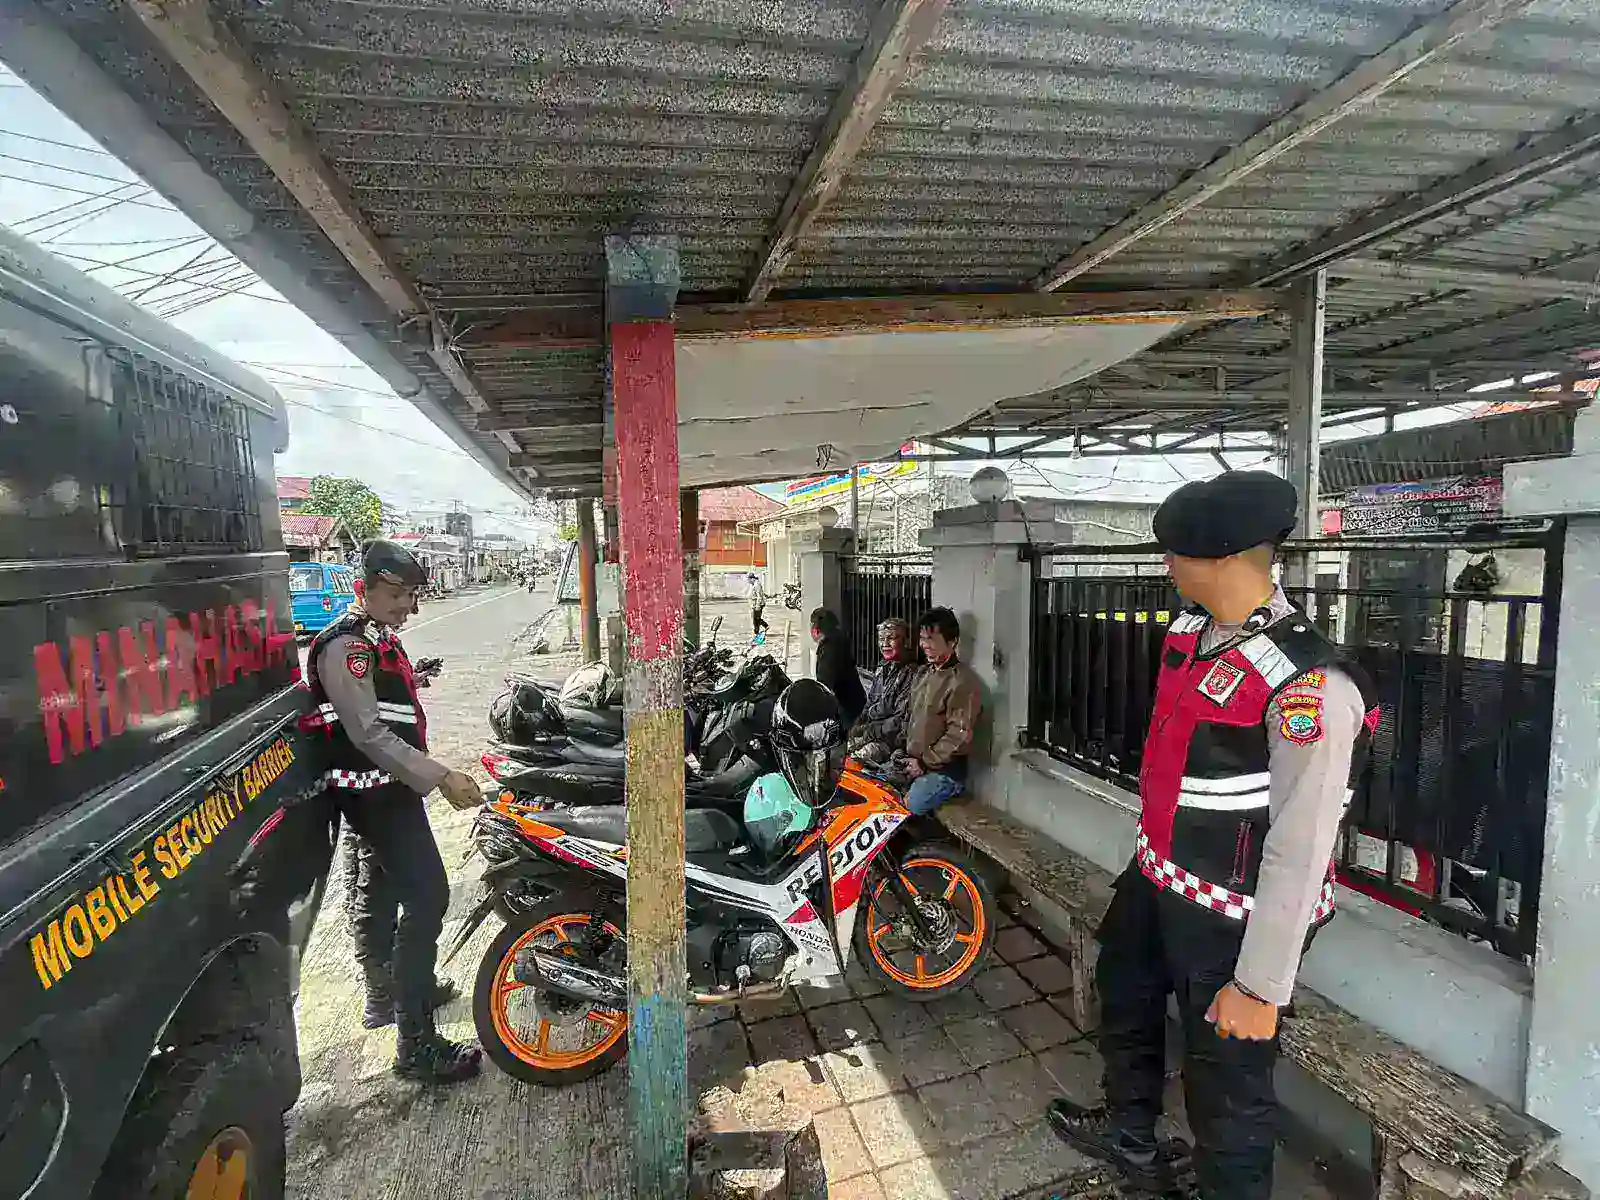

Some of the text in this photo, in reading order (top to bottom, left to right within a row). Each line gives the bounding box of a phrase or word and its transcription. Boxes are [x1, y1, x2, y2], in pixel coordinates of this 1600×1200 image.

[29, 738, 296, 990] MOBILE SECURITY BARRIER
[786, 817, 888, 904] REPSOL
[790, 926, 831, 947] HONDA
